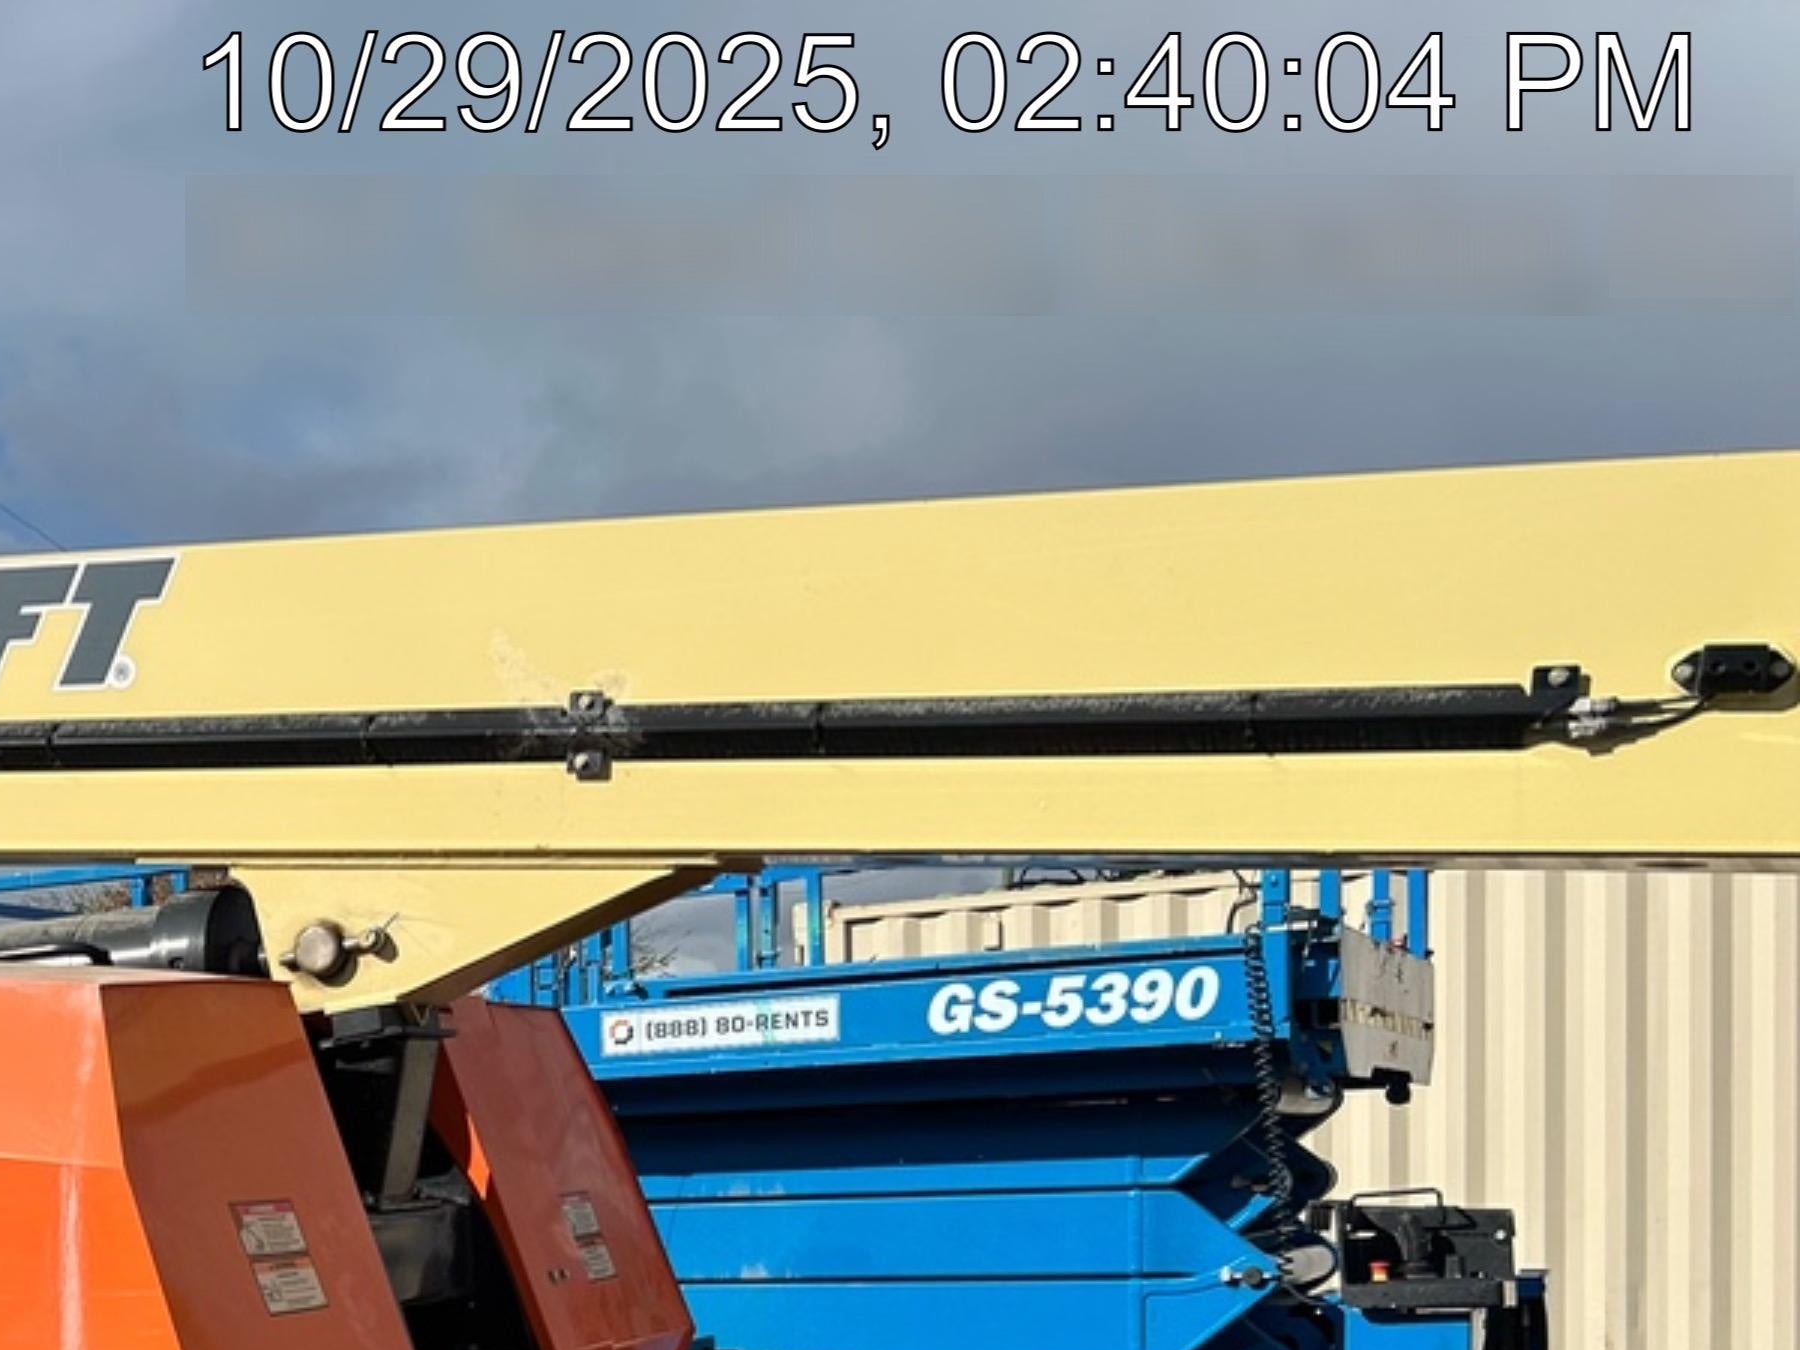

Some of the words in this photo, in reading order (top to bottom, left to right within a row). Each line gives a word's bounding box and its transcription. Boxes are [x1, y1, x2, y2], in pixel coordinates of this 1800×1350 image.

[645, 1018, 708, 1041] (888)
[715, 1008, 830, 1035] 80-RENTS
[926, 965, 1220, 1036] GS-5390
